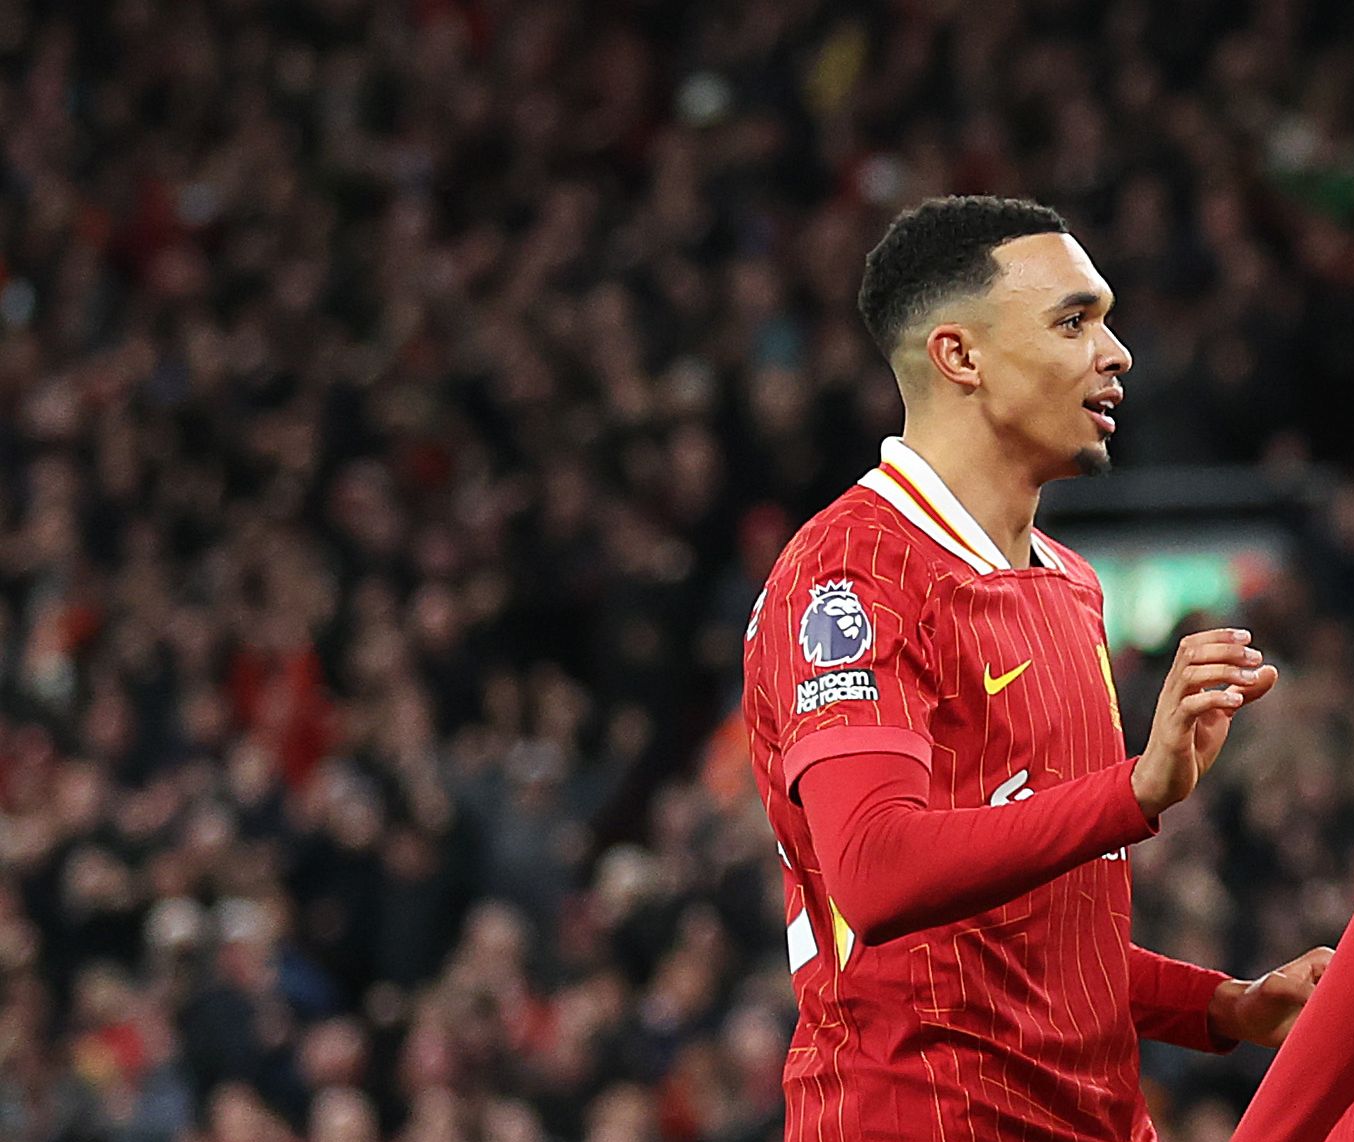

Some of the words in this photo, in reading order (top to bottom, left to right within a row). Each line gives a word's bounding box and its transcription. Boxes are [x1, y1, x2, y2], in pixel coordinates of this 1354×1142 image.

[797, 680, 819, 699] No
[819, 671, 869, 691] room
[796, 695, 819, 714] for
[820, 686, 879, 705] racism
